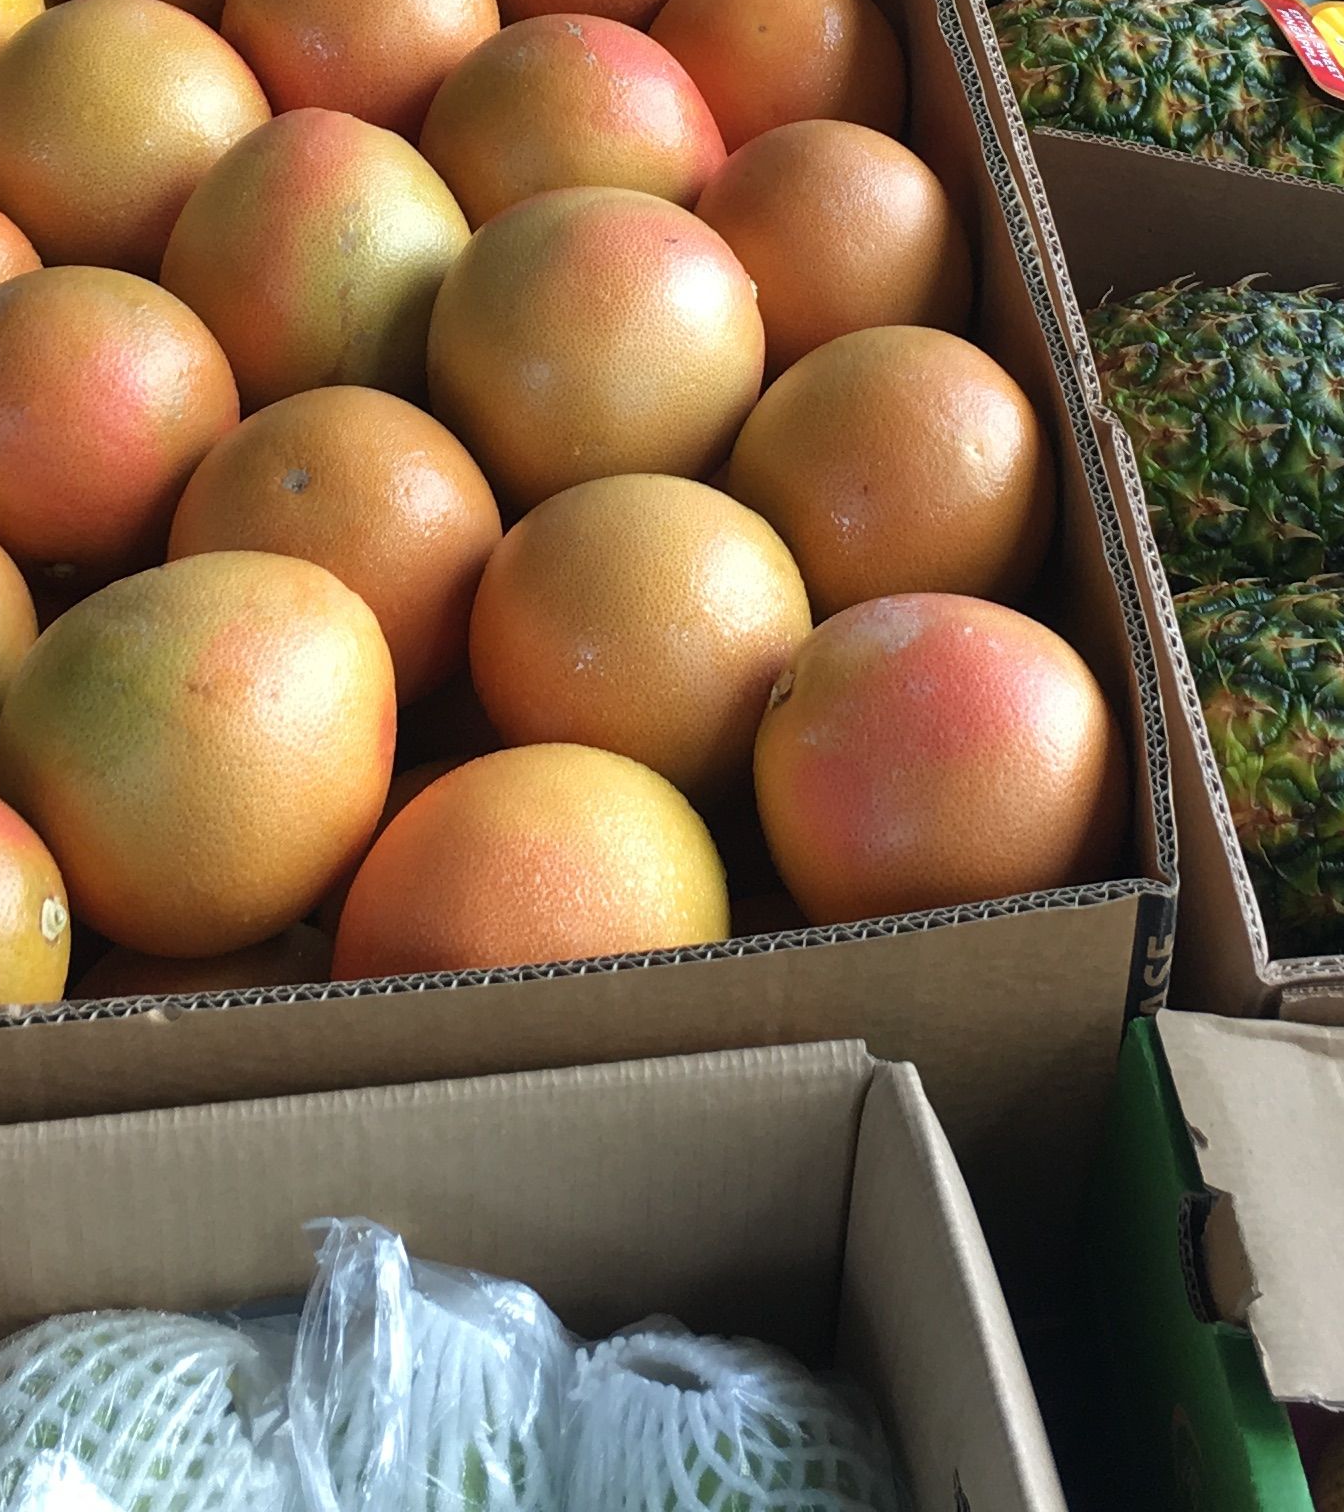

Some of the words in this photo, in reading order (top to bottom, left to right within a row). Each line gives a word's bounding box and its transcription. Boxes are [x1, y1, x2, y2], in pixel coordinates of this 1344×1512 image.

[1276, 8, 1325, 69] PINEAPPLE
[1287, 7, 1317, 45] EXTRA
[1313, 41, 1344, 83] SWEET
